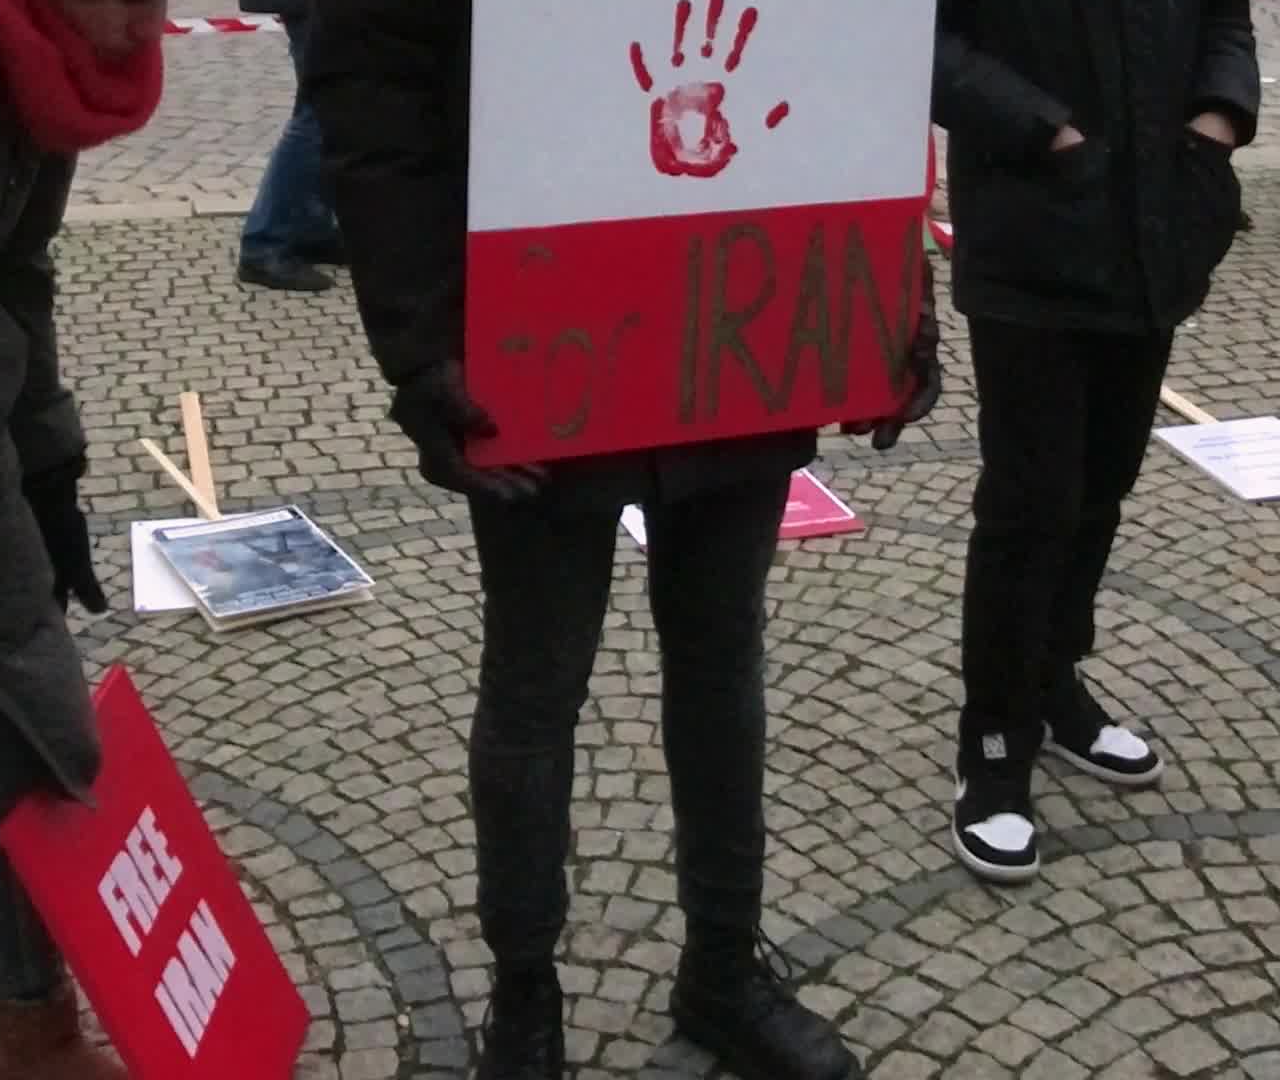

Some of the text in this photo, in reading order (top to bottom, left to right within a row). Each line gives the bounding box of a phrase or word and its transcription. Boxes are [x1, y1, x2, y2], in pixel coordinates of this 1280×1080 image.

[676, 216, 924, 425] IRAN
[96, 804, 183, 959] FREE
[153, 897, 236, 1060] IRAN
